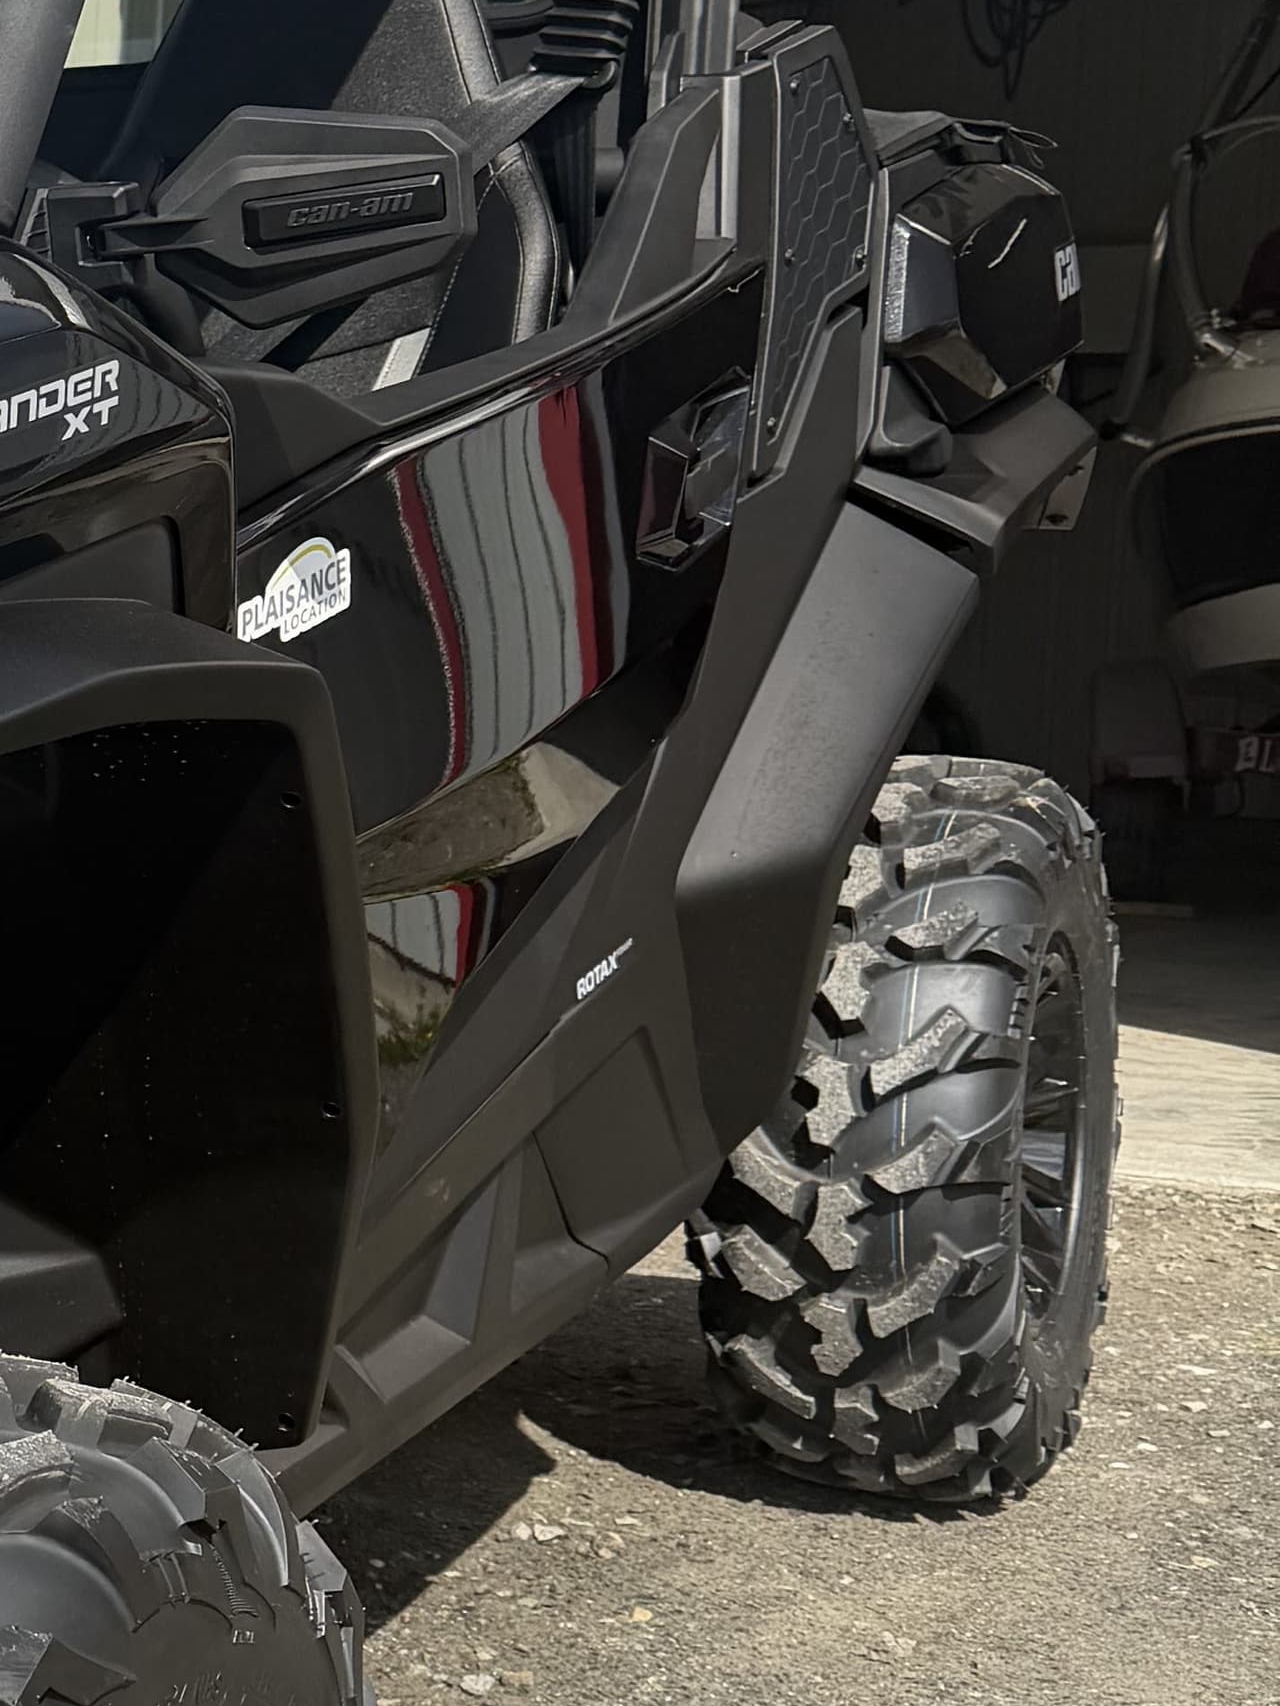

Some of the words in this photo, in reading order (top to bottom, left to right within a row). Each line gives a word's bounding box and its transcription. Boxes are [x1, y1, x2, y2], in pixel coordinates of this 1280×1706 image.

[286, 192, 414, 228] can-am
[61, 395, 120, 441] XT
[241, 556, 347, 637] PLAISANCE
[283, 587, 347, 635] LOCATION
[576, 951, 618, 1000] ROTAX
